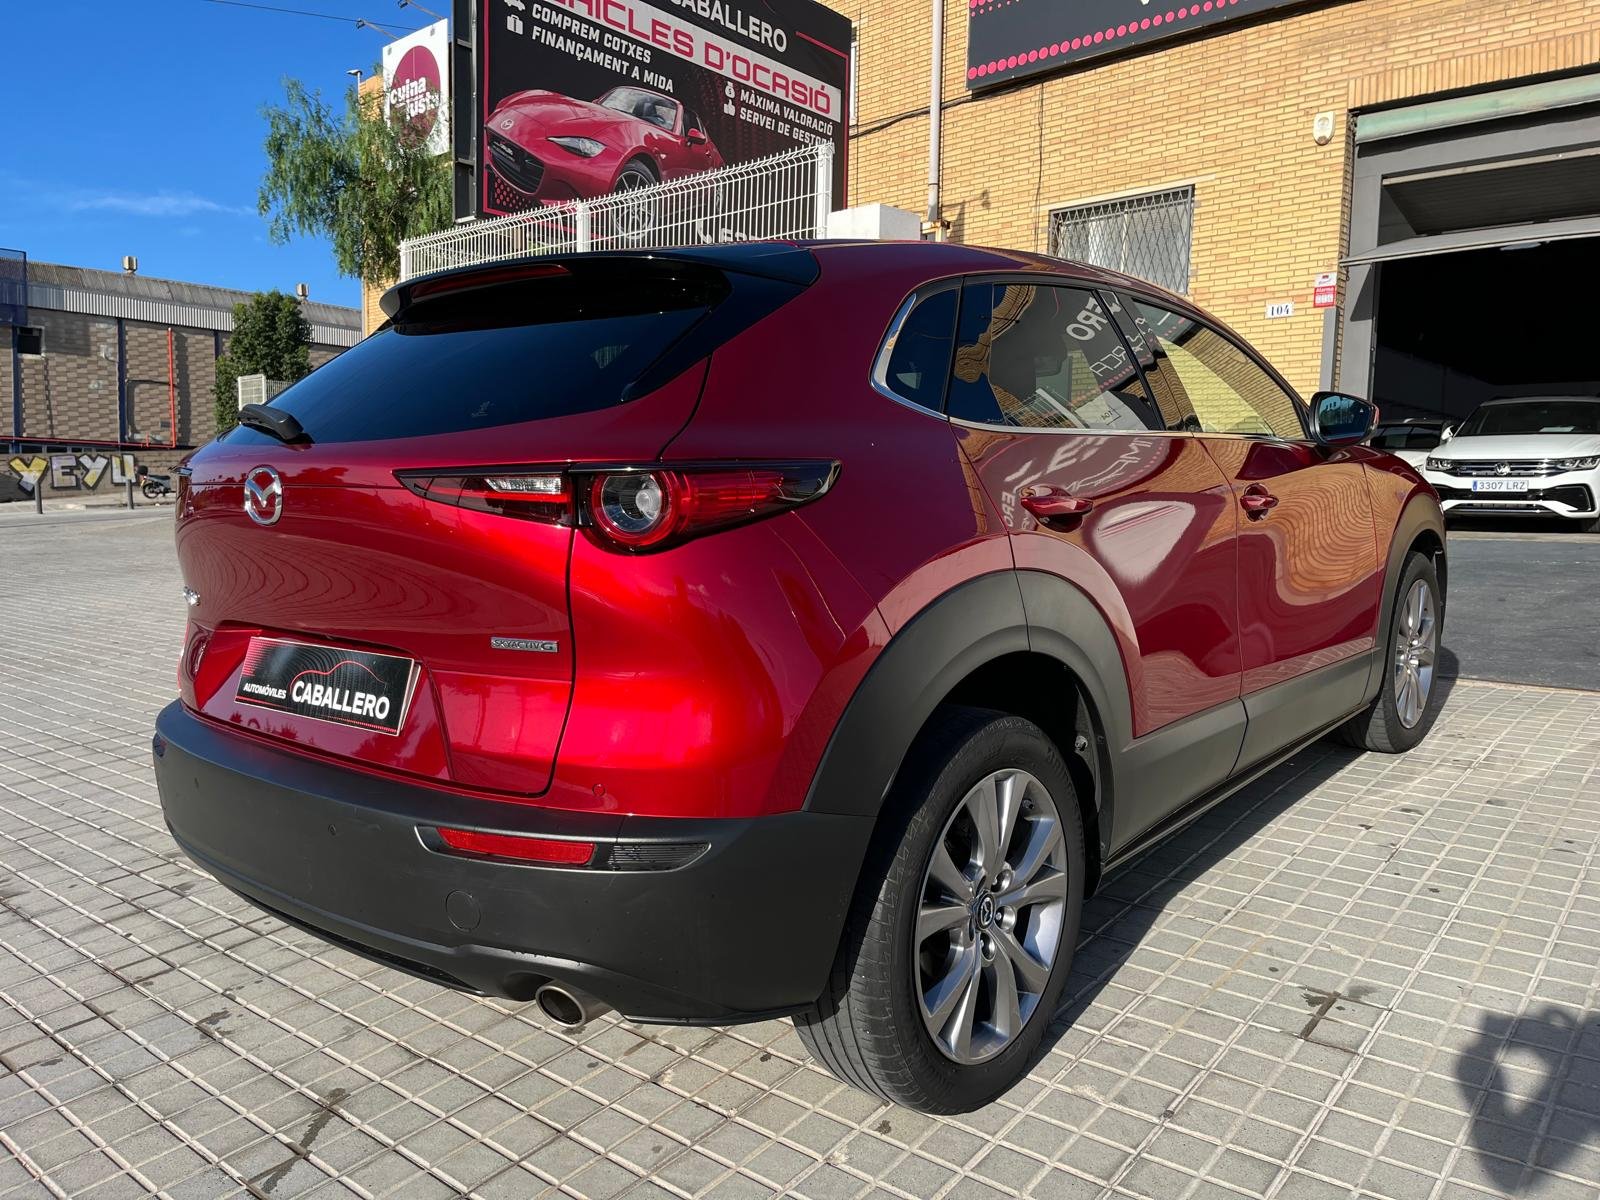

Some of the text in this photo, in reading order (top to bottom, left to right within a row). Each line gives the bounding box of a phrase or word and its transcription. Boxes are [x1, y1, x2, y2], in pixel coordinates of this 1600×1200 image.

[531, 3, 652, 64] COMPREM COTXES
[670, 0, 788, 53] ABALLERO
[531, 25, 674, 93] FINANÇAMENT A MIDA
[704, 41, 831, 114] D'OCASIÓ
[405, 92, 441, 121] just
[740, 89, 833, 136] MÀXIMA VALORACIÓ
[740, 108, 775, 131] SERVEI
[778, 121, 790, 136] DE
[1270, 304, 1290, 316] 104
[1479, 481, 1526, 491] 3307 LRZ
[242, 680, 390, 720] AUTOMÓVILES CABALLERO
